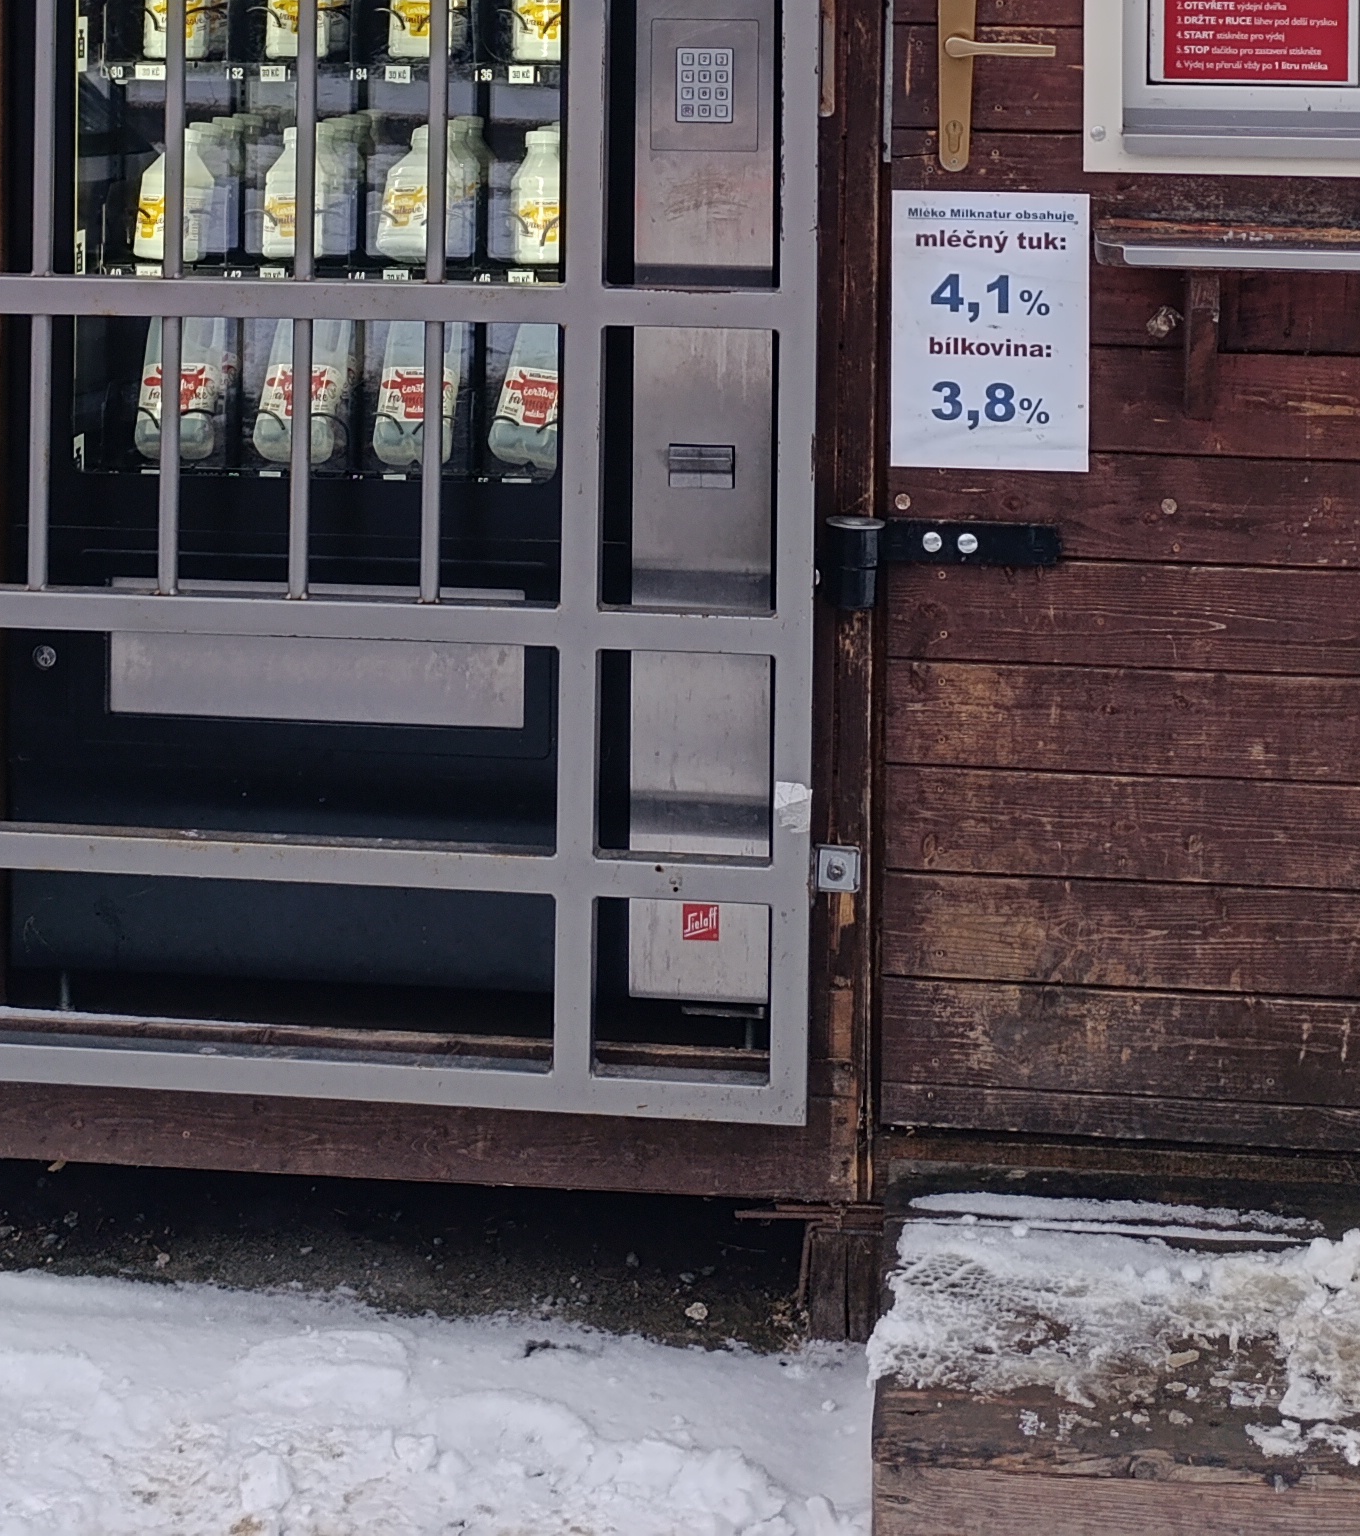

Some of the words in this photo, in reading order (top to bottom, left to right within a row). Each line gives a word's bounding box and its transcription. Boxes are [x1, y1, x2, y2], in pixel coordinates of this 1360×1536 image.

[907, 207, 946, 219] Mléko
[950, 208, 1011, 220] Milknatur
[1015, 210, 1075, 222] obsahuje
[916, 230, 1008, 253] mléčný
[1017, 232, 1066, 250] tuk:
[930, 337, 1051, 357] bílkovina:
[683, 906, 718, 939] Sielaff
